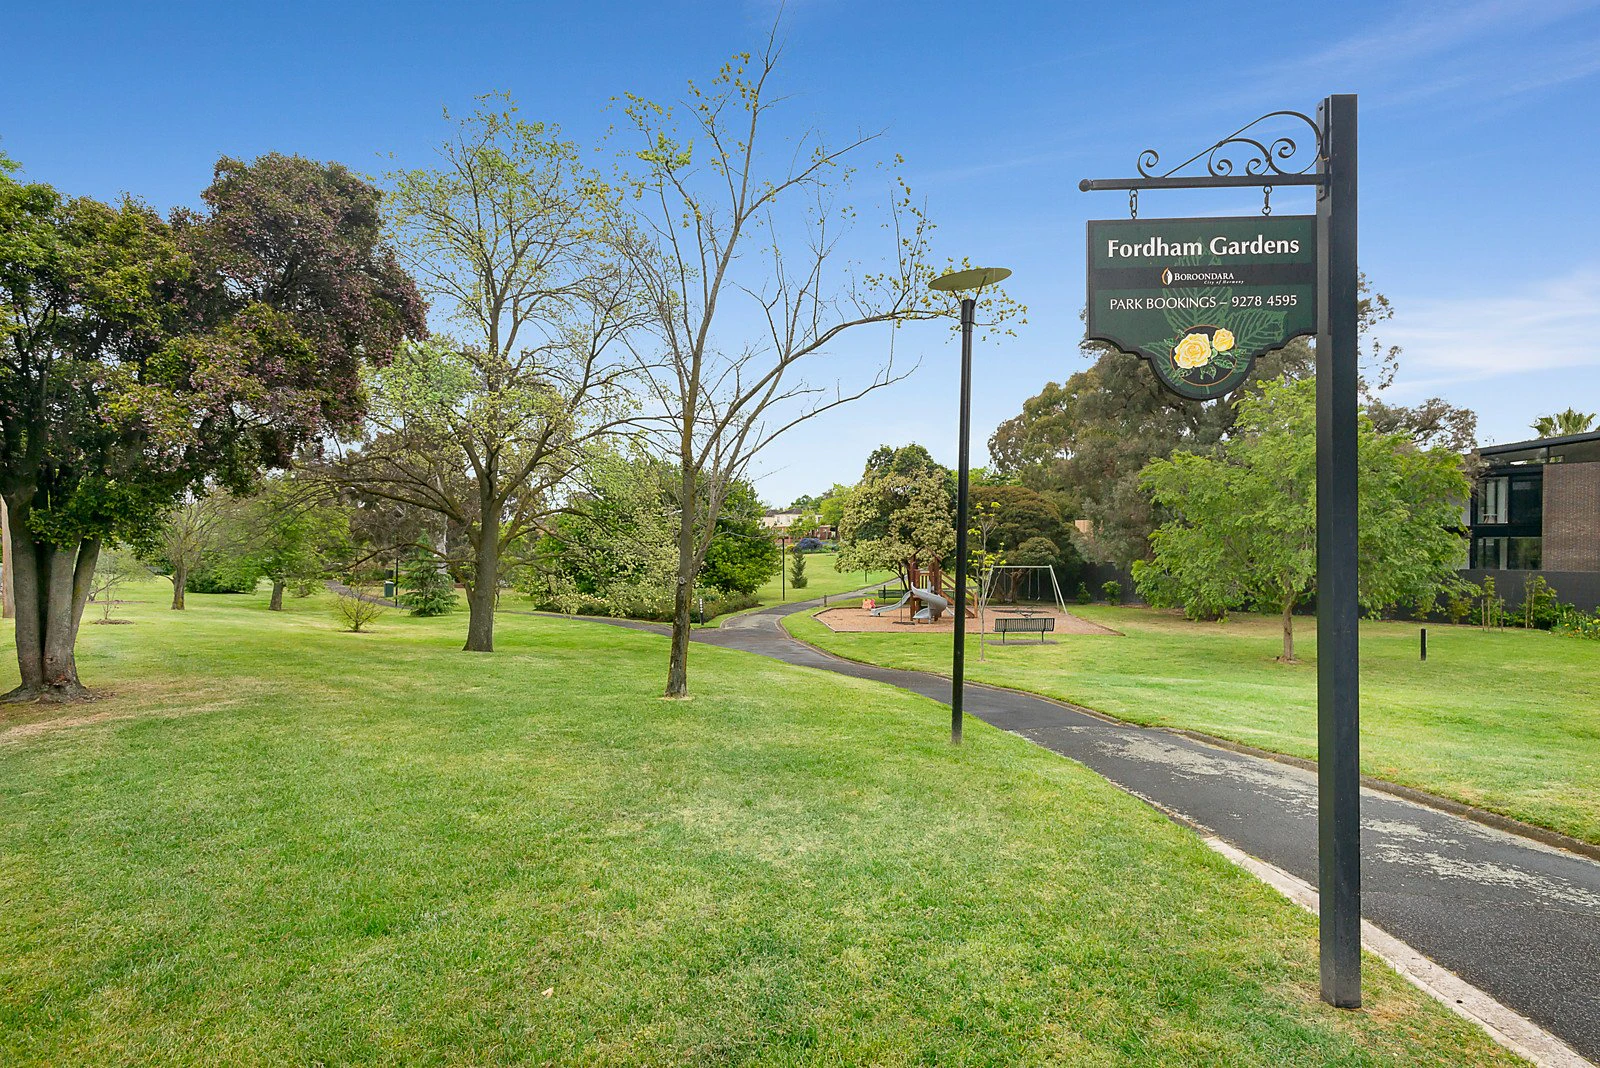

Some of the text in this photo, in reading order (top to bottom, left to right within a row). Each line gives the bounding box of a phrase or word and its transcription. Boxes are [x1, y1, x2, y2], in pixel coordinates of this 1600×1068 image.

[1107, 234, 1299, 258] Fordham Gardens
[1174, 272, 1234, 281] BOROONDARA
[1110, 298, 1143, 310] PARK
[1147, 297, 1216, 309] BOOKINGS
[1231, 296, 1262, 308] 9278
[1267, 295, 1297, 306] 4595
